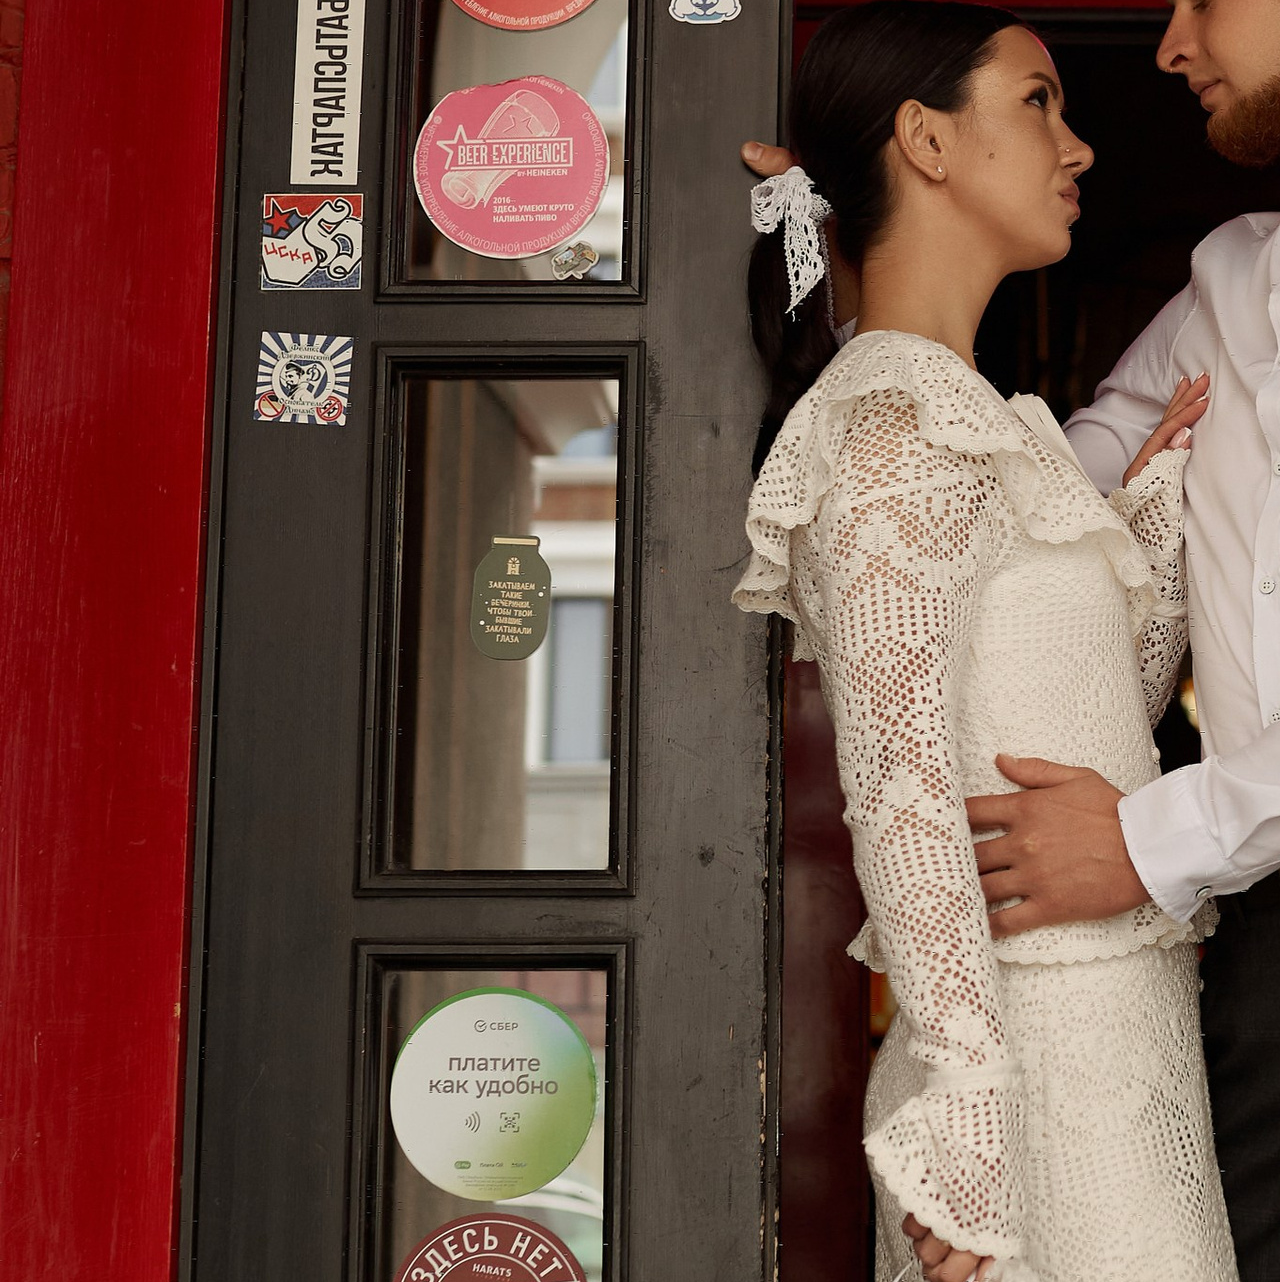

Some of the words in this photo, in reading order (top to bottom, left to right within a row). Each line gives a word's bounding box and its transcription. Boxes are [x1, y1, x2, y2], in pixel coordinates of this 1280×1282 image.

[581, 111, 605, 159] ЗДОРОВЬЮ
[418, 125, 437, 179] ЧРЕЗМЕРНОЕ
[457, 145, 488, 166] BEER
[492, 143, 568, 165] EXPERIENCE
[526, 169, 568, 177] HEINEKEN
[593, 159, 605, 197] ВАШЕМУ
[418, 178, 458, 236] УПОТРЕБЛЕНИЕ
[493, 205, 517, 214] ЗДЕСЬ
[518, 204, 548, 212] УМЕЮТ
[549, 204, 575, 212] КРУТО
[571, 196, 595, 227] ВРЕДИТ
[493, 215, 534, 223] НАЛИВАТЬ
[535, 214, 557, 222] ПИВО
[457, 229, 521, 253] АЛКОГОЛЬНОЙ
[522, 222, 572, 251] ПРОДУКЦИИ
[264, 242, 313, 264] ЦСКА
[488, 581, 536, 591] ЗАКАТЫВАЕМ
[501, 590, 523, 600] ТАКИЕ
[487, 607, 512, 616] ЧТОБЫ
[513, 609, 533, 617] ТВОИ
[495, 616, 523, 626] БЫВШИЕ
[485, 625, 532, 634] ЗАКАТЫВАЛИ
[496, 634, 520, 643] ГЛАЗА
[489, 1022, 519, 1031] СБЕР
[448, 1057, 541, 1072] платите
[429, 1078, 469, 1094] как
[475, 1074, 559, 1099] удобно
[509, 1231, 563, 1279] НЕТ
[472, 1263, 513, 1277] HARATS
